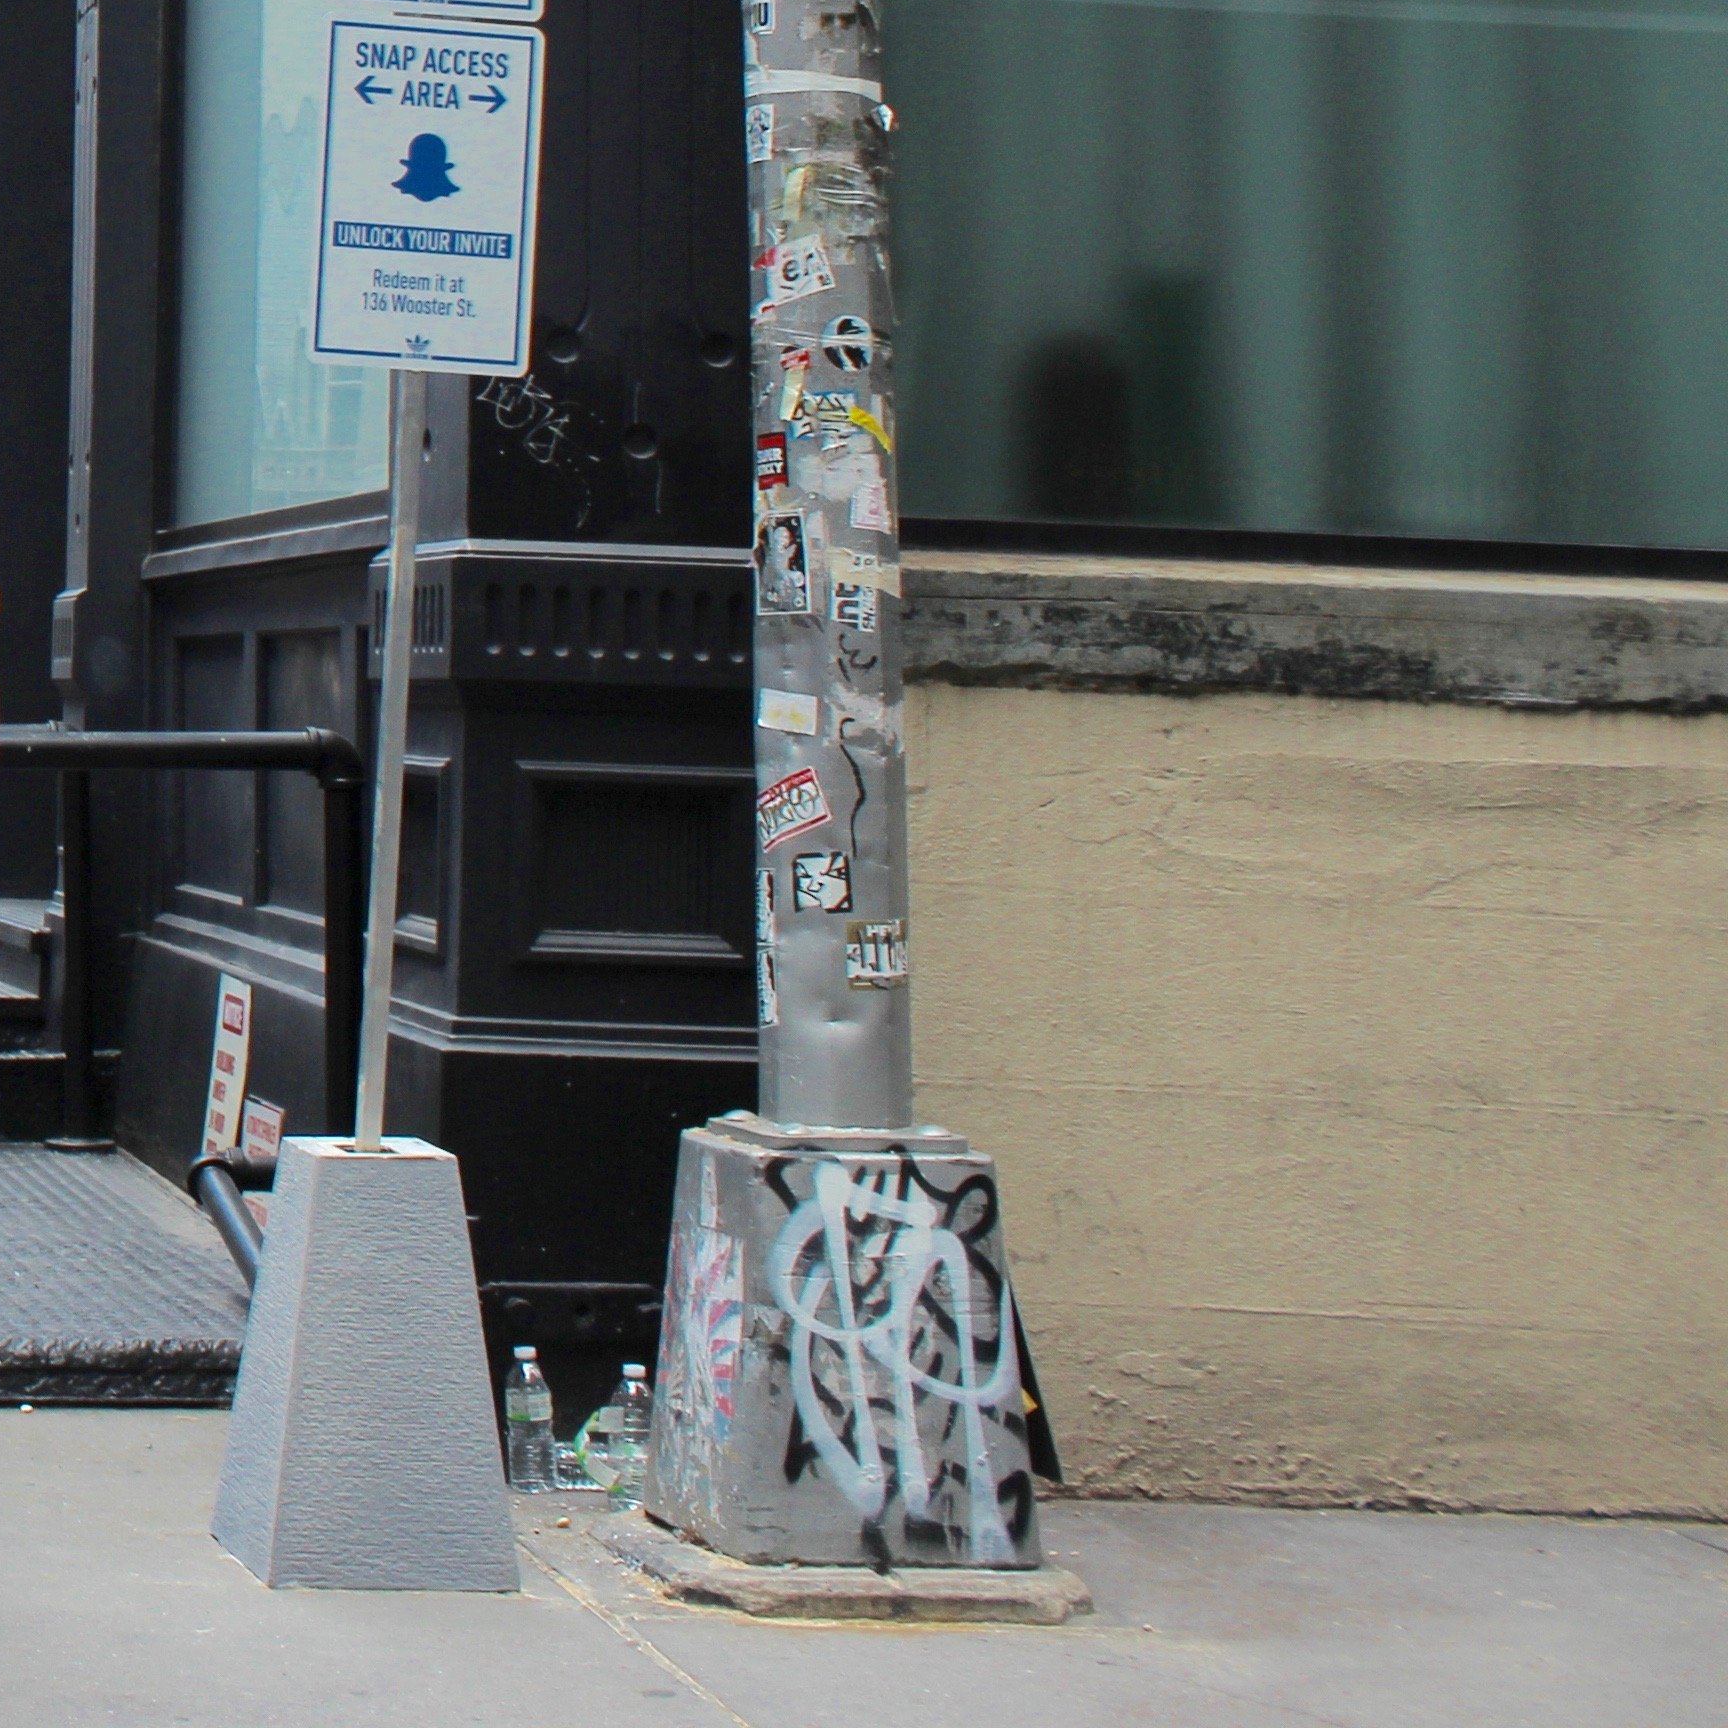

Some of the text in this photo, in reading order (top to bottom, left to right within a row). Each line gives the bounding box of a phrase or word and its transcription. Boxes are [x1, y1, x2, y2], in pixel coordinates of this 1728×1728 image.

[356, 42, 509, 78] SNAP ACCESS
[401, 81, 460, 110] AREA
[338, 223, 507, 257] UNLOCK YOUR INVITE
[373, 270, 463, 293] Redeem it at
[362, 293, 476, 317] 136 Wooster St.
